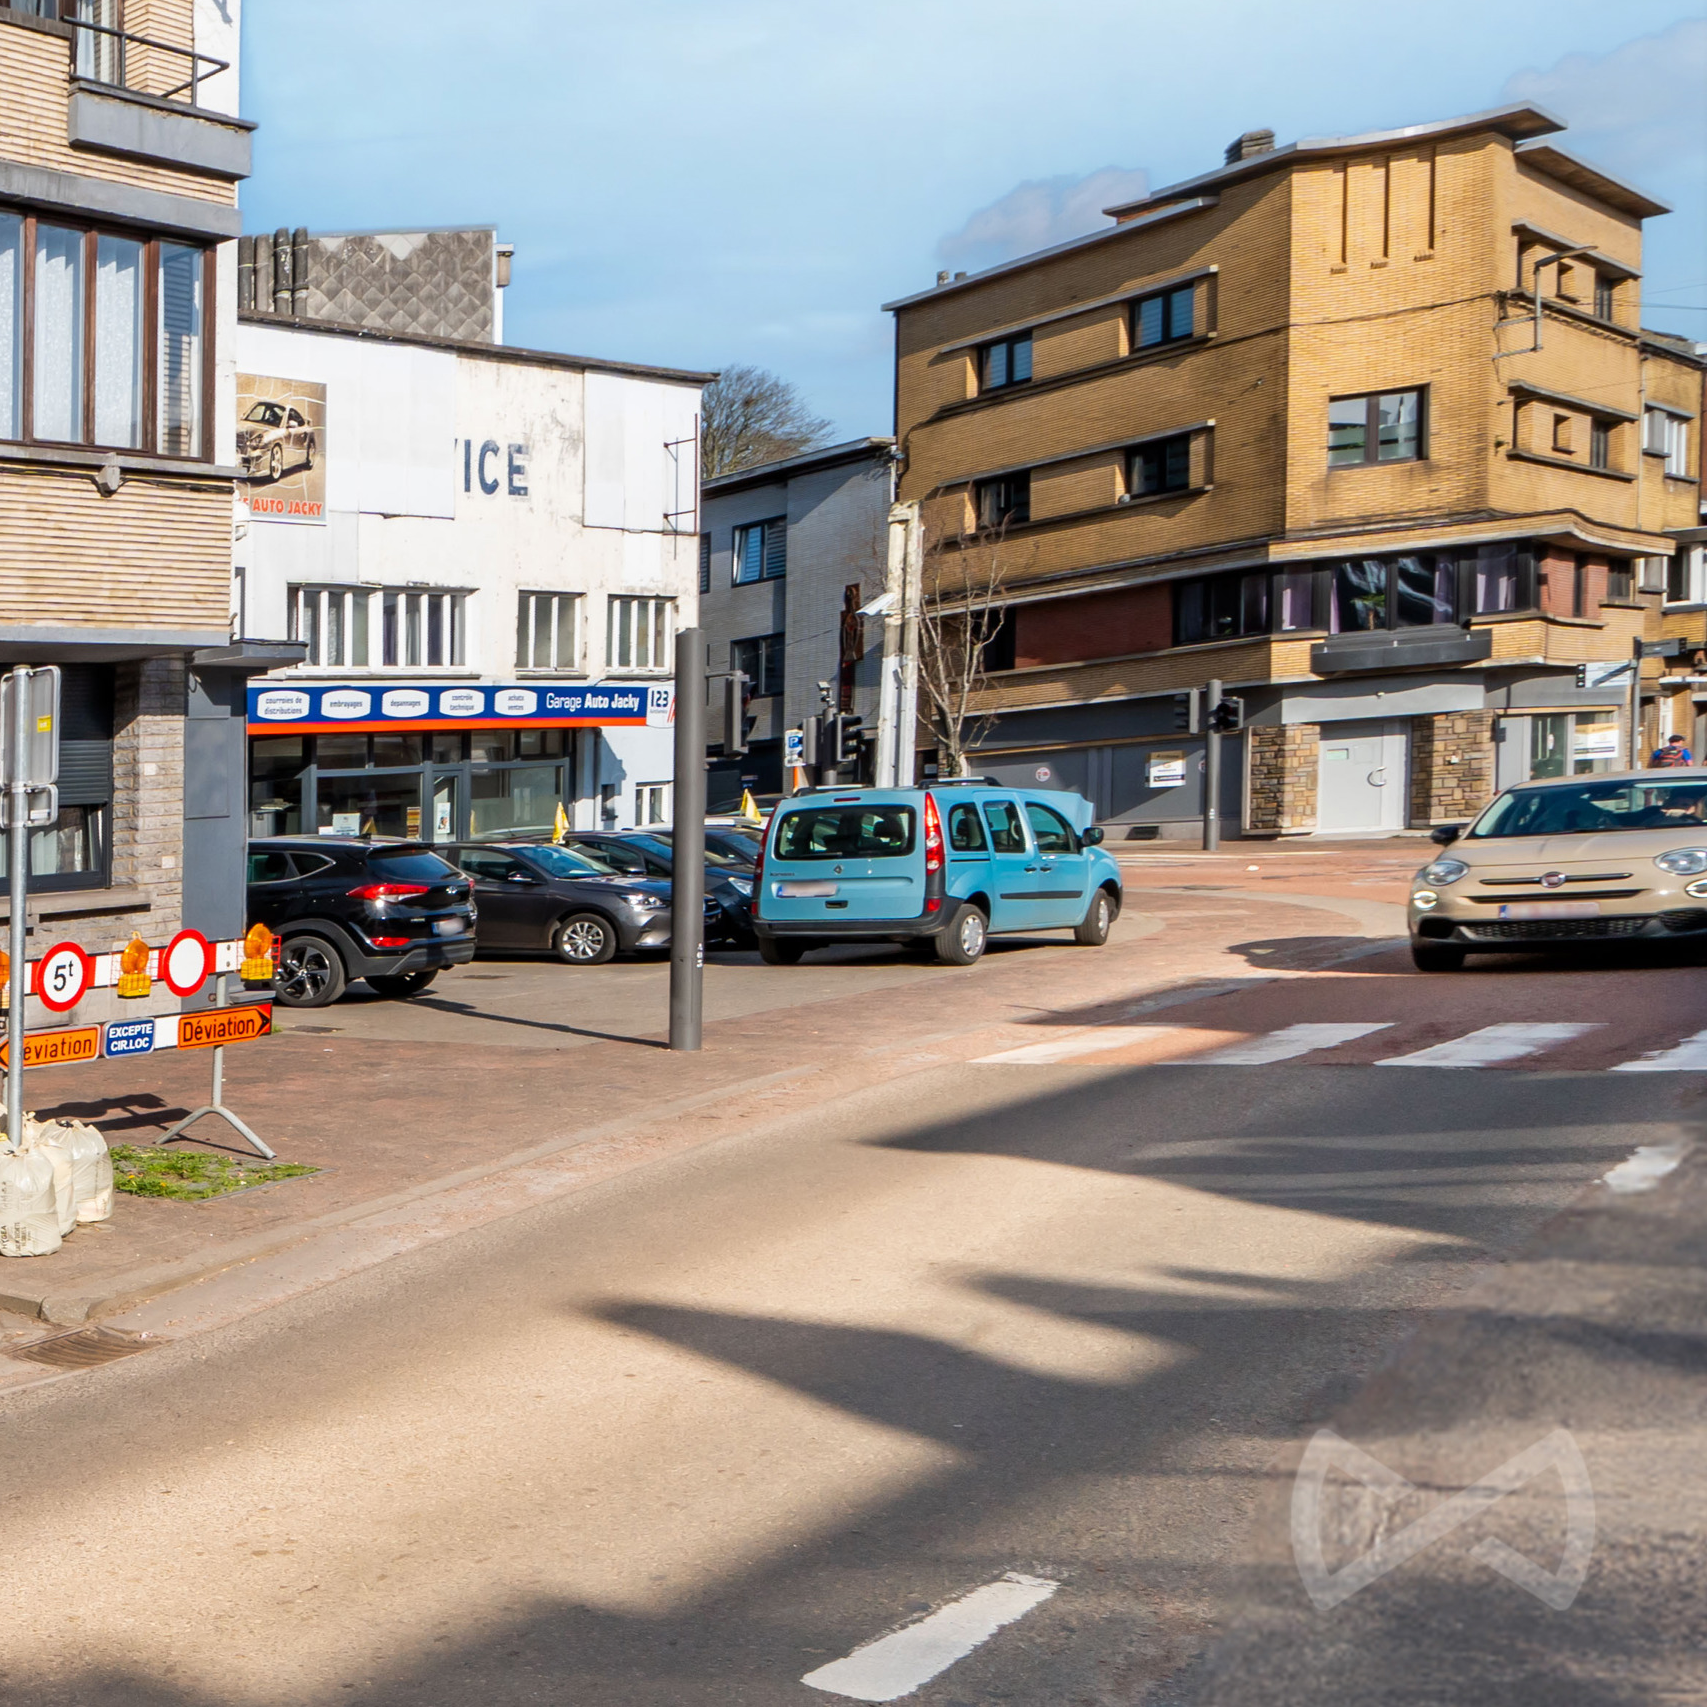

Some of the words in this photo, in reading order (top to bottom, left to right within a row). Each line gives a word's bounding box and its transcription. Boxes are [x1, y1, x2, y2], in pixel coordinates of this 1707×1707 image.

[454, 438, 529, 496] ICE
[252, 498, 284, 513] AUTO
[288, 500, 322, 516] JACKY
[295, 696, 303, 704] de
[329, 700, 363, 709] embrayages
[546, 692, 582, 712] Garage
[584, 692, 609, 709] Auto
[611, 692, 640, 712] Jacky
[650, 690, 669, 707] 123
[790, 737, 799, 748] P
[109, 1022, 153, 1039] EXCEPTE
[183, 1015, 255, 1043] Déviation
[23, 1035, 92, 1061] éviation
[110, 1036, 150, 1052] CIR.LOC
